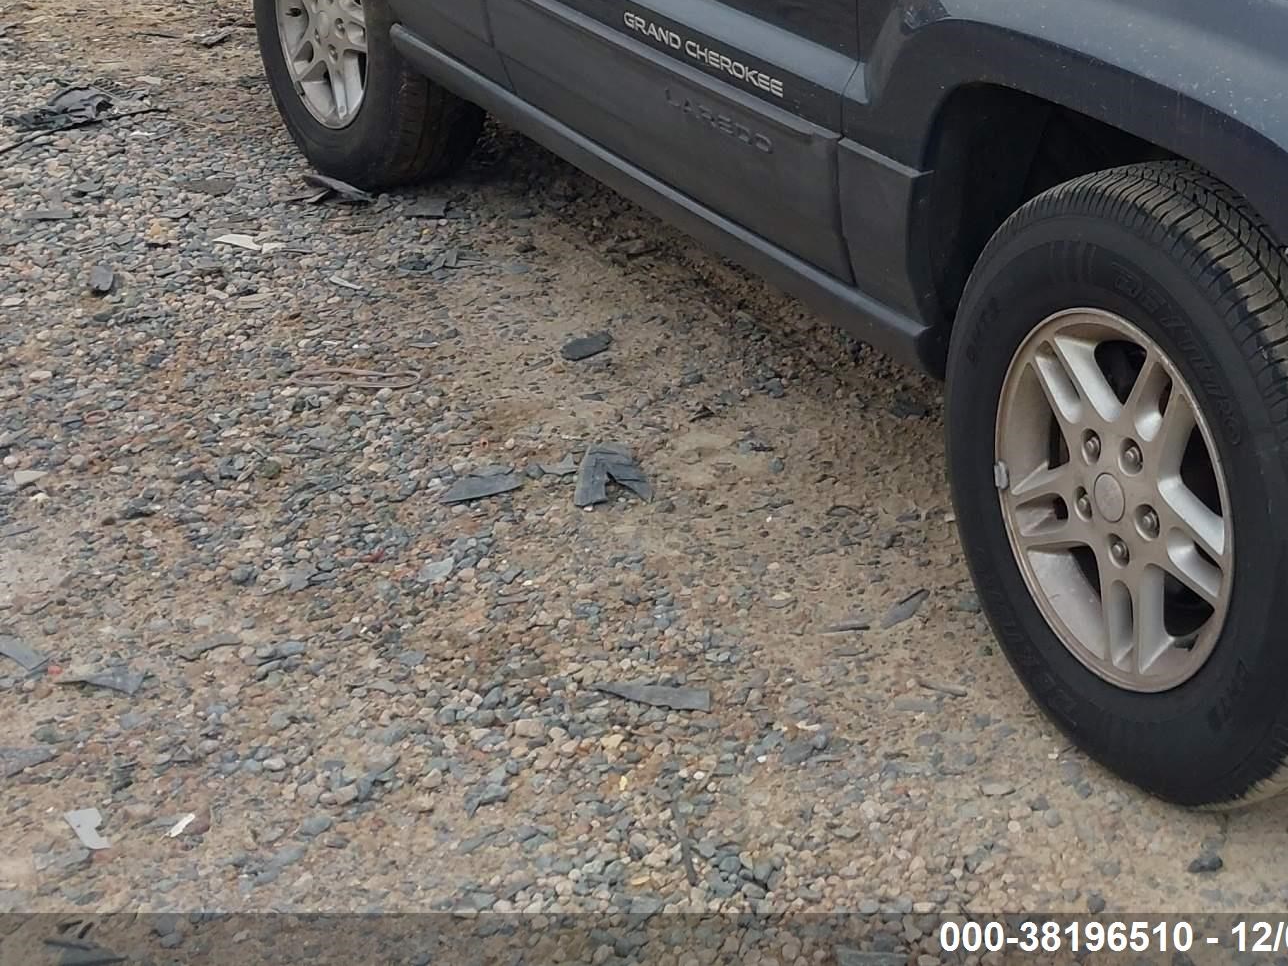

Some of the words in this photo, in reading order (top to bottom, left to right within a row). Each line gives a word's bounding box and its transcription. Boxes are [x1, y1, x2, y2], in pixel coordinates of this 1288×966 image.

[623, 12, 682, 50] GRAND
[685, 40, 784, 98] CHEROKEE
[664, 88, 774, 154] LAREDO
